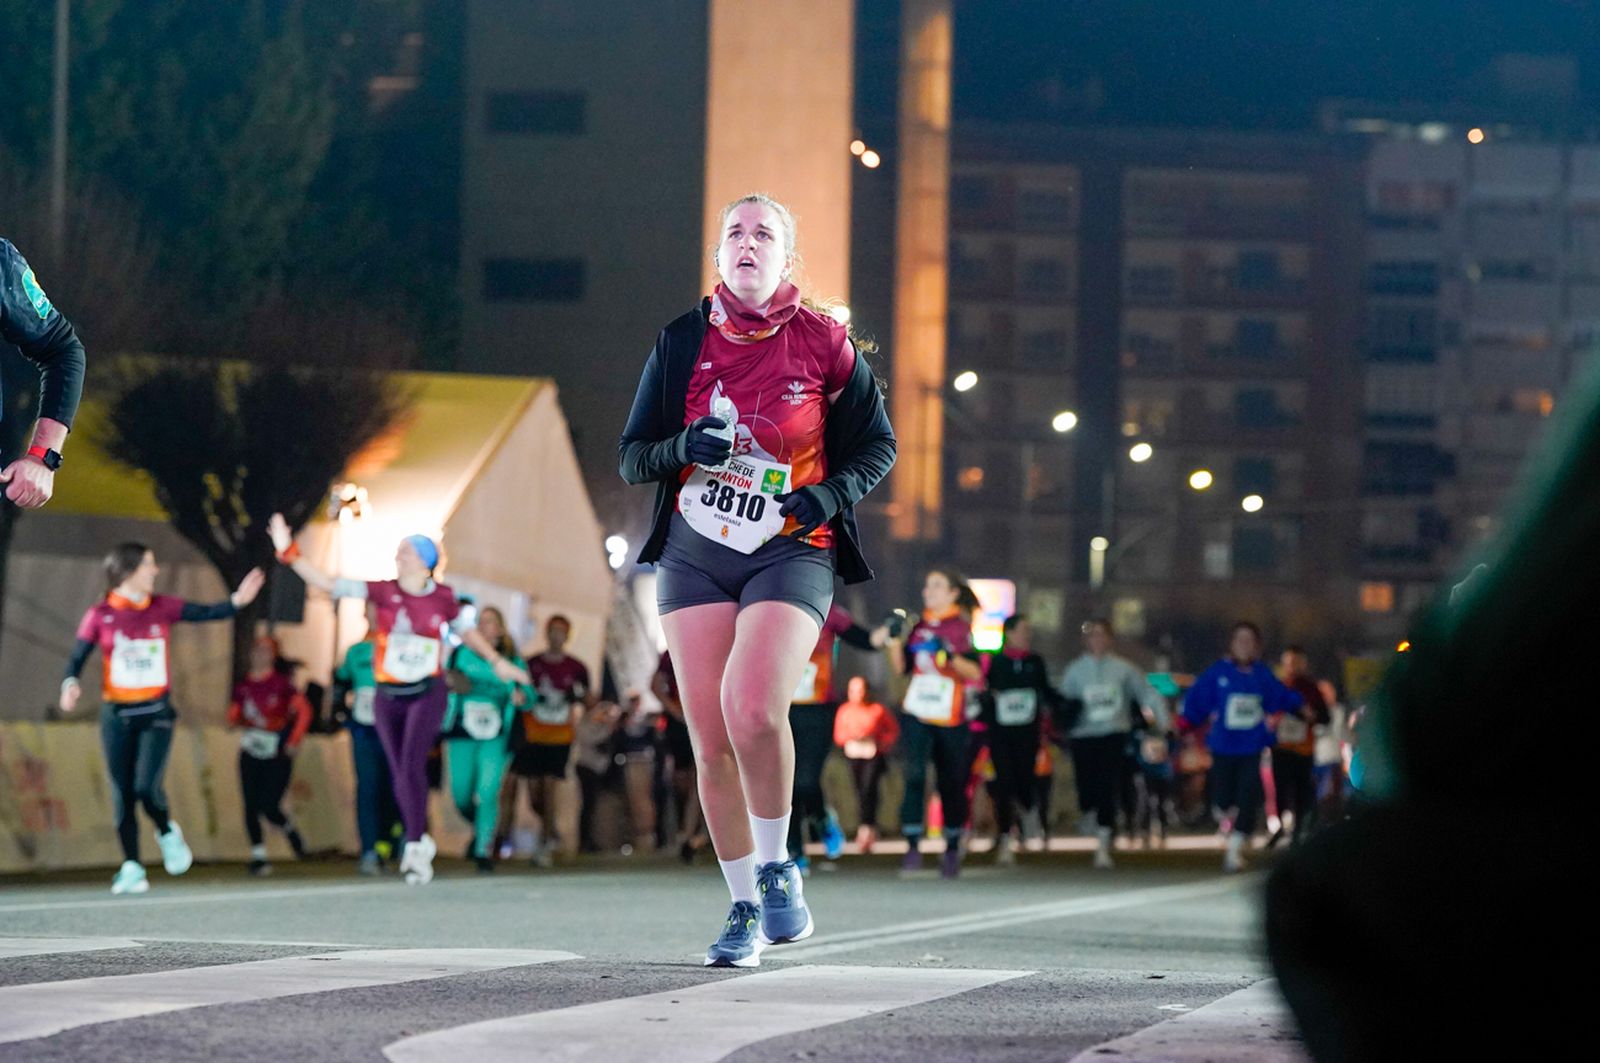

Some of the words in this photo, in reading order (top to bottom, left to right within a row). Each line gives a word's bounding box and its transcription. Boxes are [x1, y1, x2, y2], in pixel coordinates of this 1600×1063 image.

[728, 461, 743, 474] CHE
[742, 467, 756, 478] DE
[720, 471, 753, 489] ANTÓN
[700, 479, 766, 522] 3810
